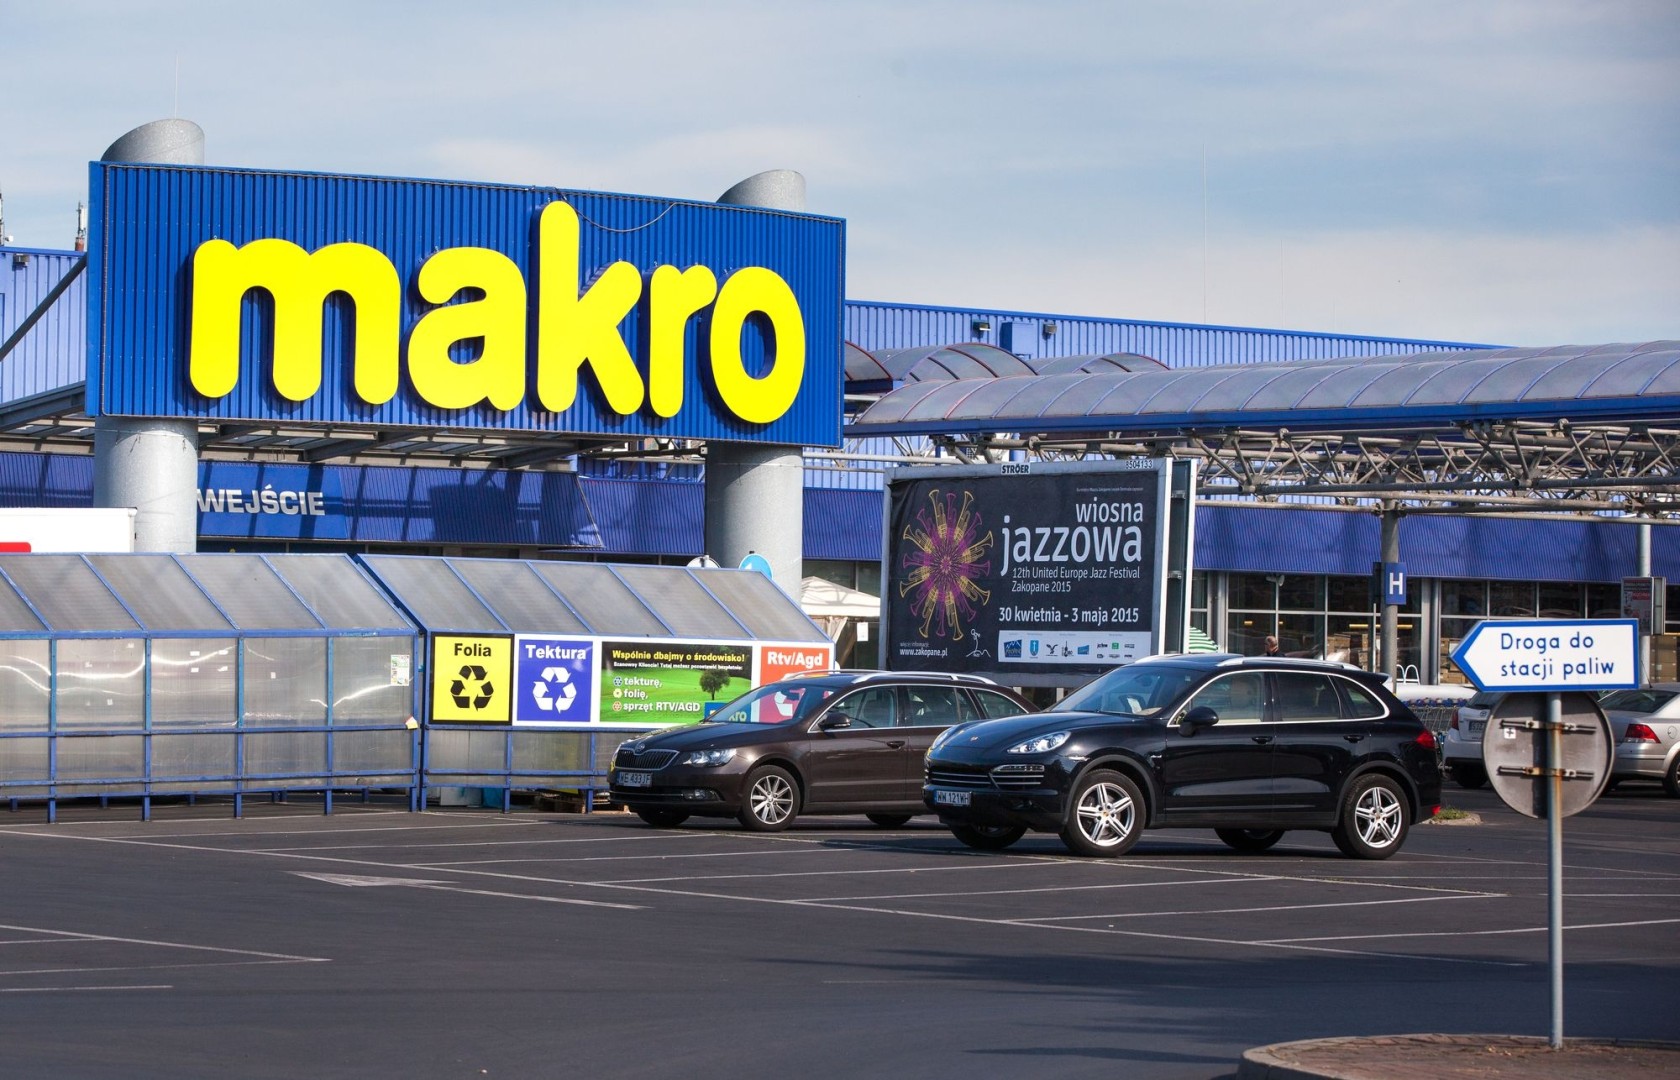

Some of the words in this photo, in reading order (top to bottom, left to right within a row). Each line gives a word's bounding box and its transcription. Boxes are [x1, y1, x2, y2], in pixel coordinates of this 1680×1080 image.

[190, 200, 807, 424] makro
[1001, 464, 1029, 474] STRÖER
[197, 484, 325, 516] WEJŚCIE
[1075, 496, 1144, 523] wiosna
[1000, 515, 1142, 577] jazzowa
[1012, 567, 1030, 578] 12th
[1032, 567, 1058, 578] United
[1060, 567, 1088, 581] Europe
[1089, 568, 1107, 578] Jazz
[1109, 566, 1140, 579] Festival
[1011, 581, 1050, 594] Zakopane
[1051, 581, 1071, 592] 2015
[1389, 572, 1404, 595] H
[999, 607, 1012, 621] 30
[1014, 606, 1061, 622] kwietnia
[1071, 608, 1079, 622] 3
[1081, 607, 1109, 626] maja
[1111, 608, 1139, 622] 2015
[454, 643, 492, 657] Folia
[1500, 632, 1560, 654] Droga
[1569, 631, 1594, 649] do
[525, 645, 587, 660] Tektura
[612, 650, 652, 661] Wspólnie
[653, 652, 684, 662] dbajmy
[694, 653, 746, 663] środowisko!
[767, 651, 823, 667] Rtv/Agd
[900, 647, 948, 658] www.zakopane.pl
[1501, 659, 1553, 680] stacji
[1563, 657, 1614, 680] paliw
[624, 677, 662, 688] tekturę,
[624, 691, 648, 700] folię,
[624, 703, 653, 713] sprzęt
[656, 702, 700, 712] RTV/AGD
